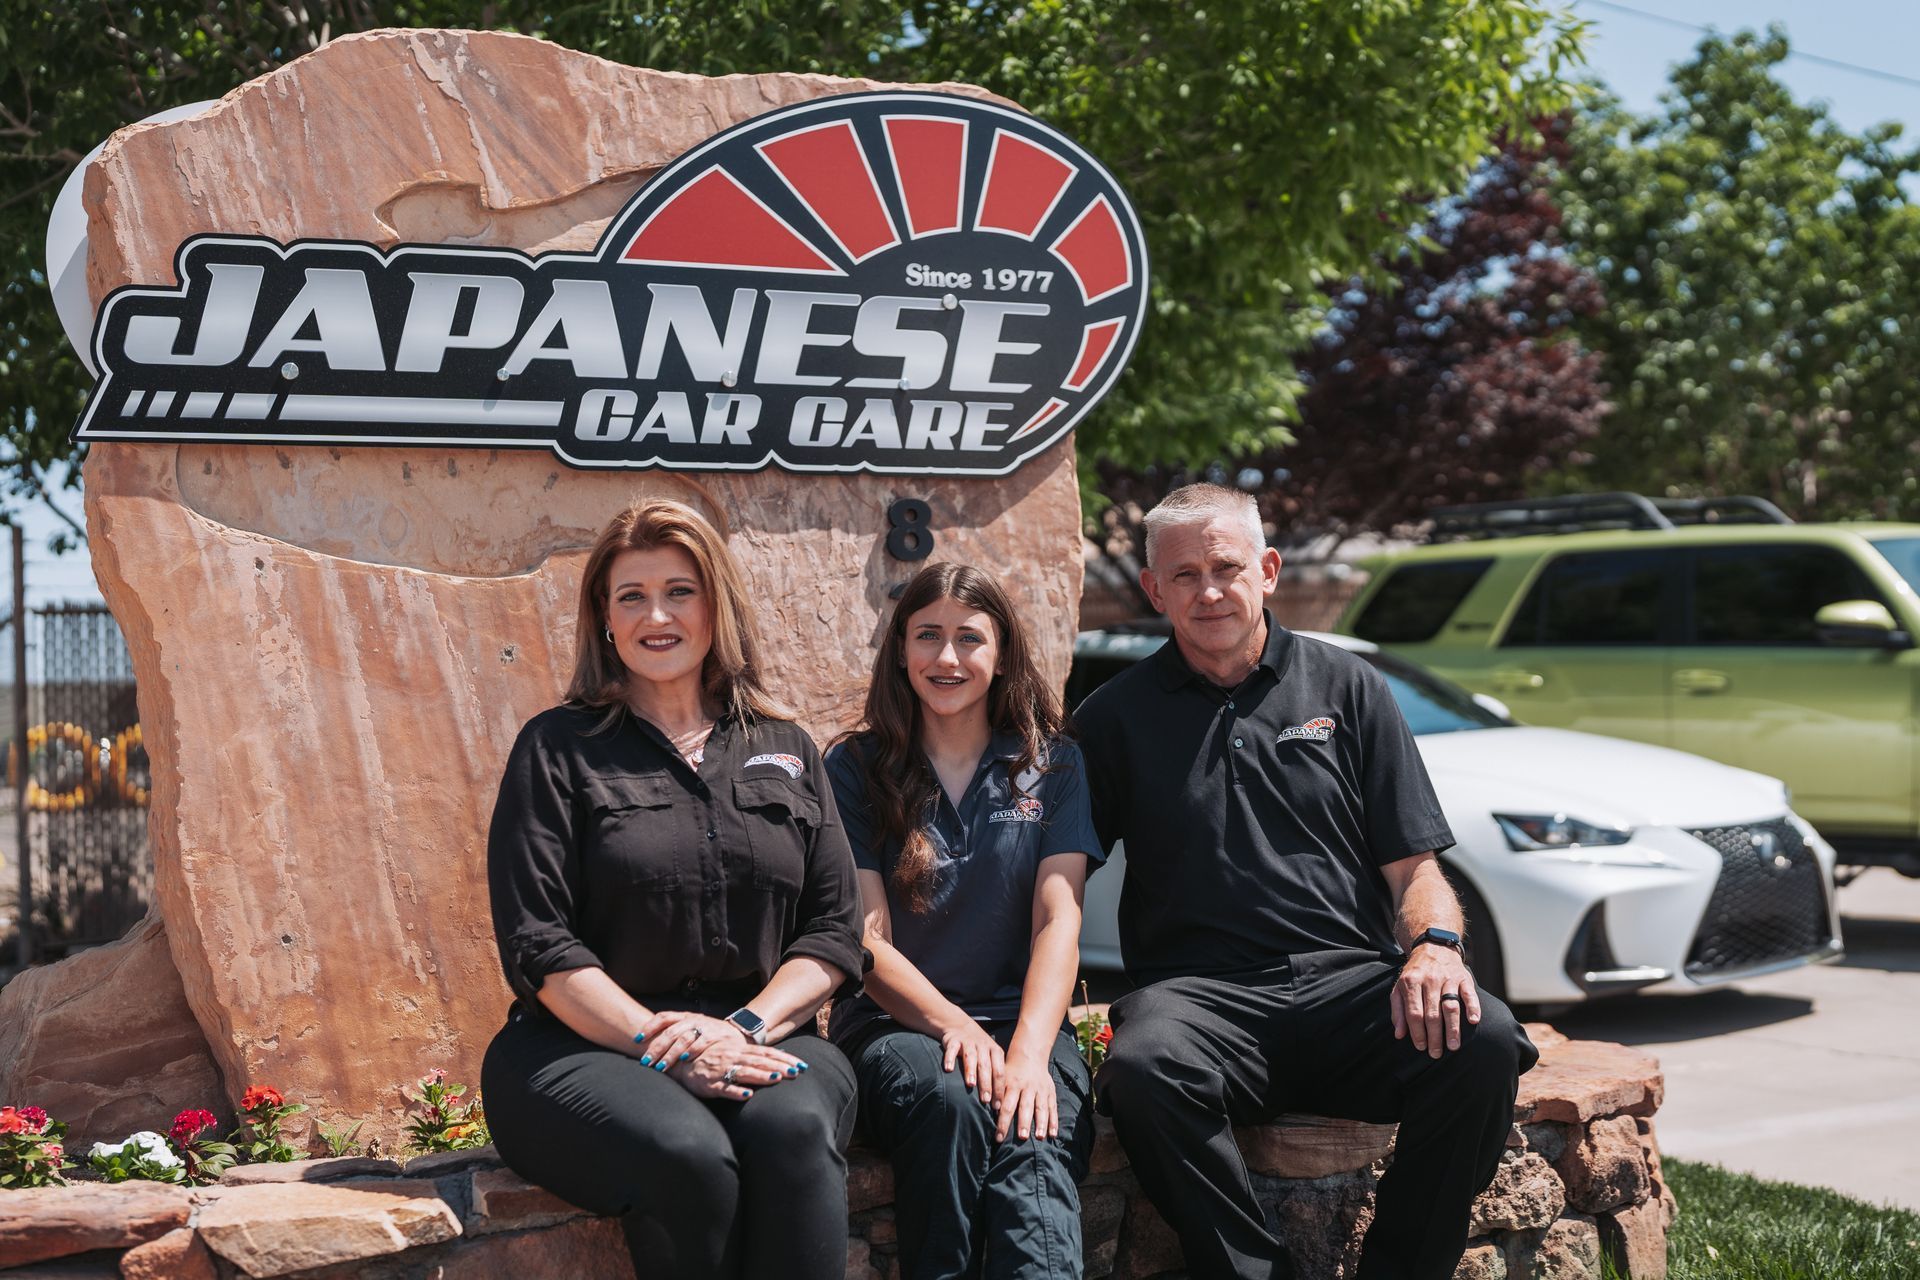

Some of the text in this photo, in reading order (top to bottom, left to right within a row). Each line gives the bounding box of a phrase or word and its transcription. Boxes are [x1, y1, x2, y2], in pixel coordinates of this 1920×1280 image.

[905, 263, 1054, 293] Since 1977
[124, 263, 1051, 393] JAPANESE
[575, 388, 1014, 452] CAR CARE
